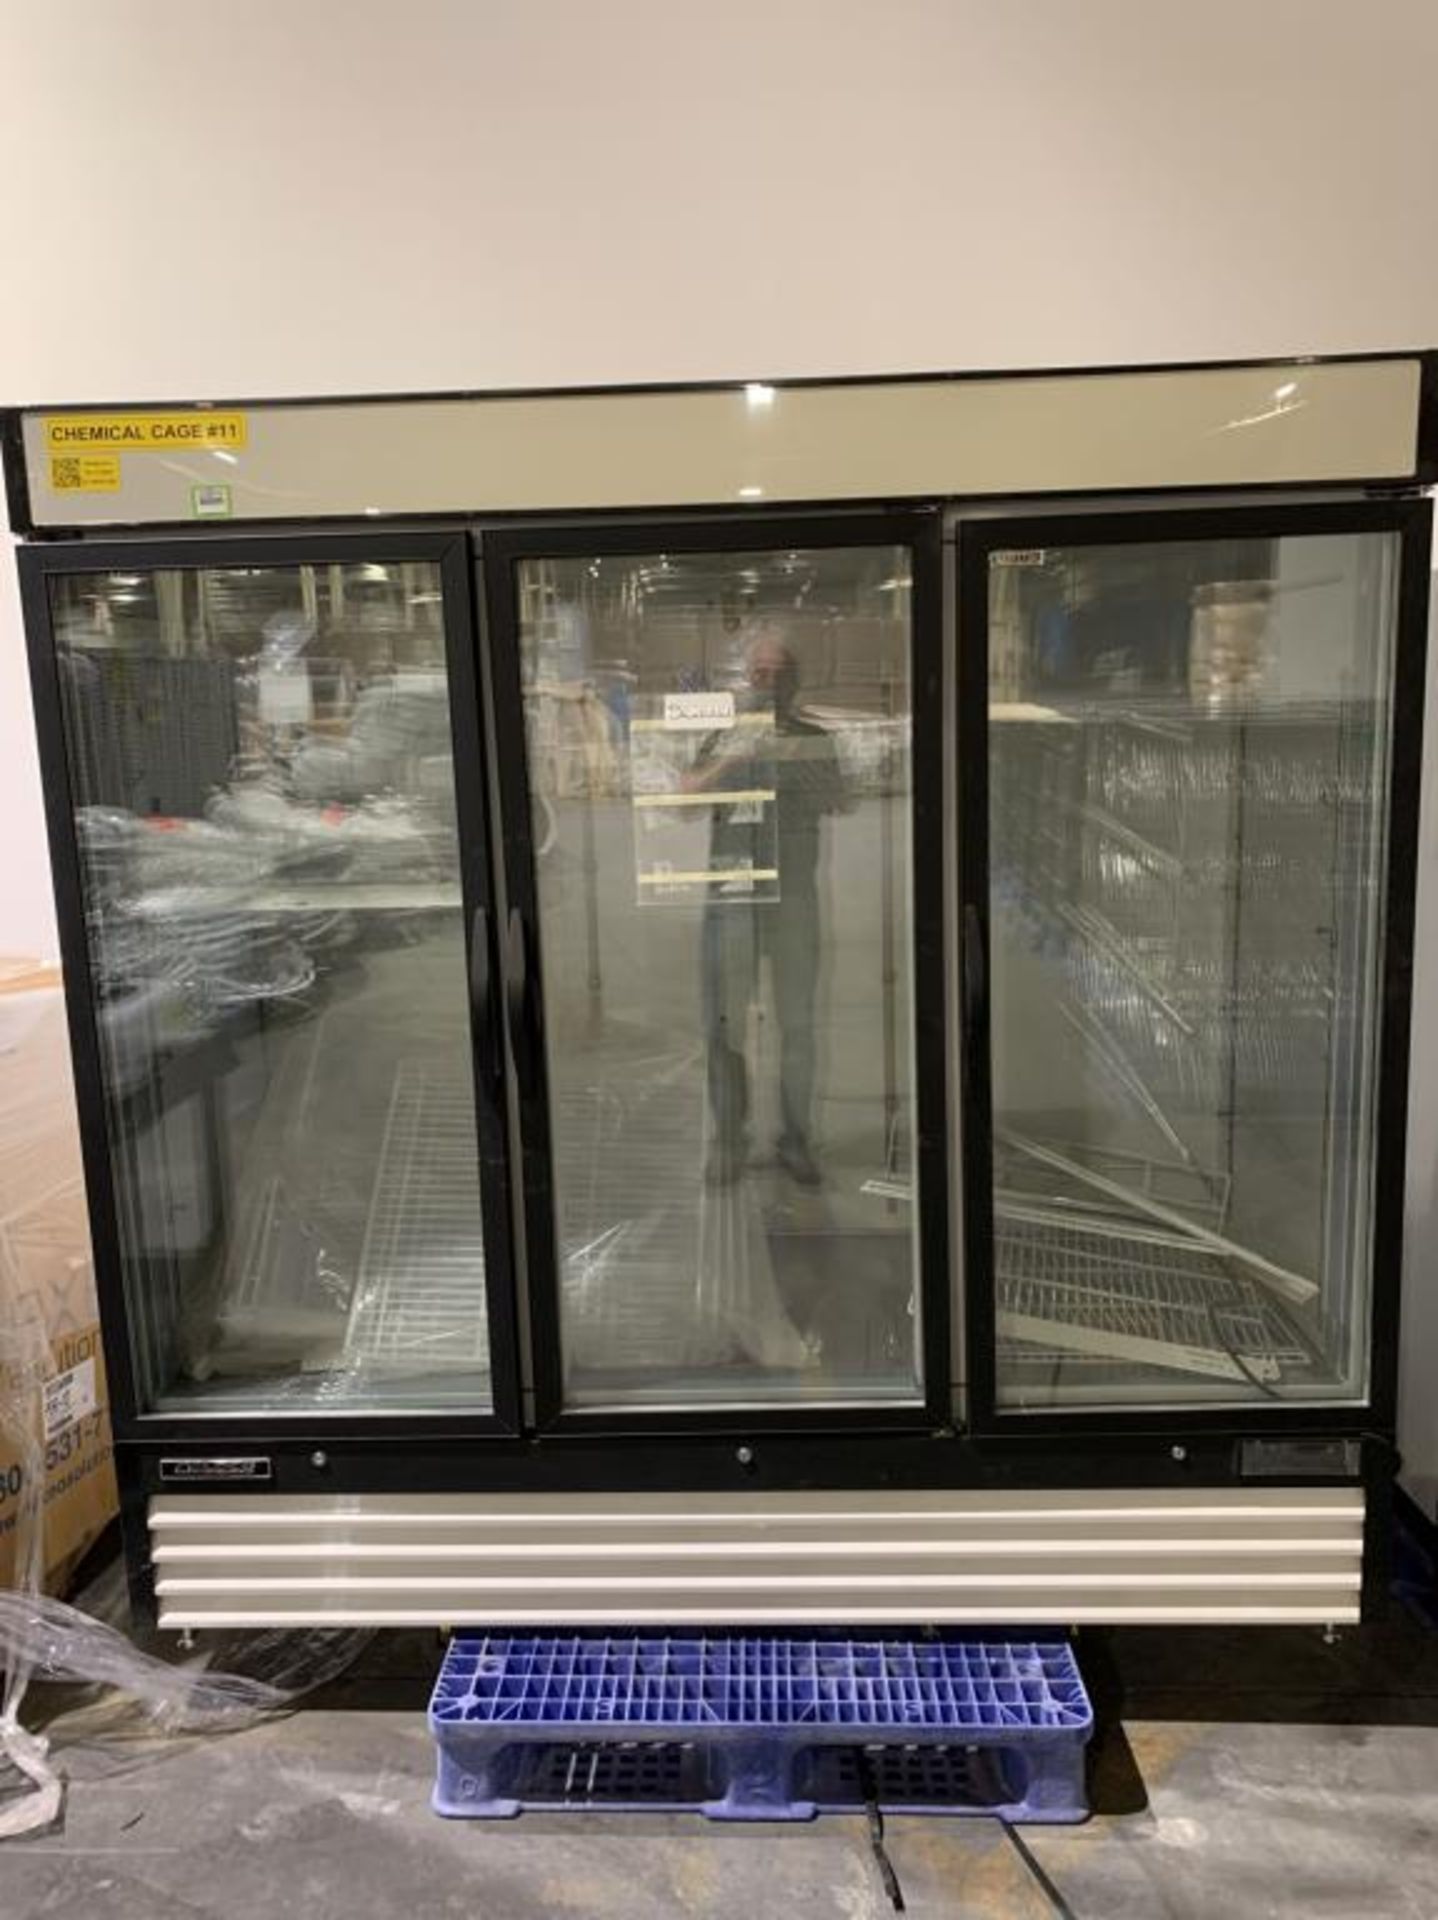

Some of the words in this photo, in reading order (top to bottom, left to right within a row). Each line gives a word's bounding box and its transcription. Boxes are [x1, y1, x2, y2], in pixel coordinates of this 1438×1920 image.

[51, 425, 145, 442] CHEMICAL
[151, 423, 203, 440] CAGE
[207, 423, 237, 438] #11
